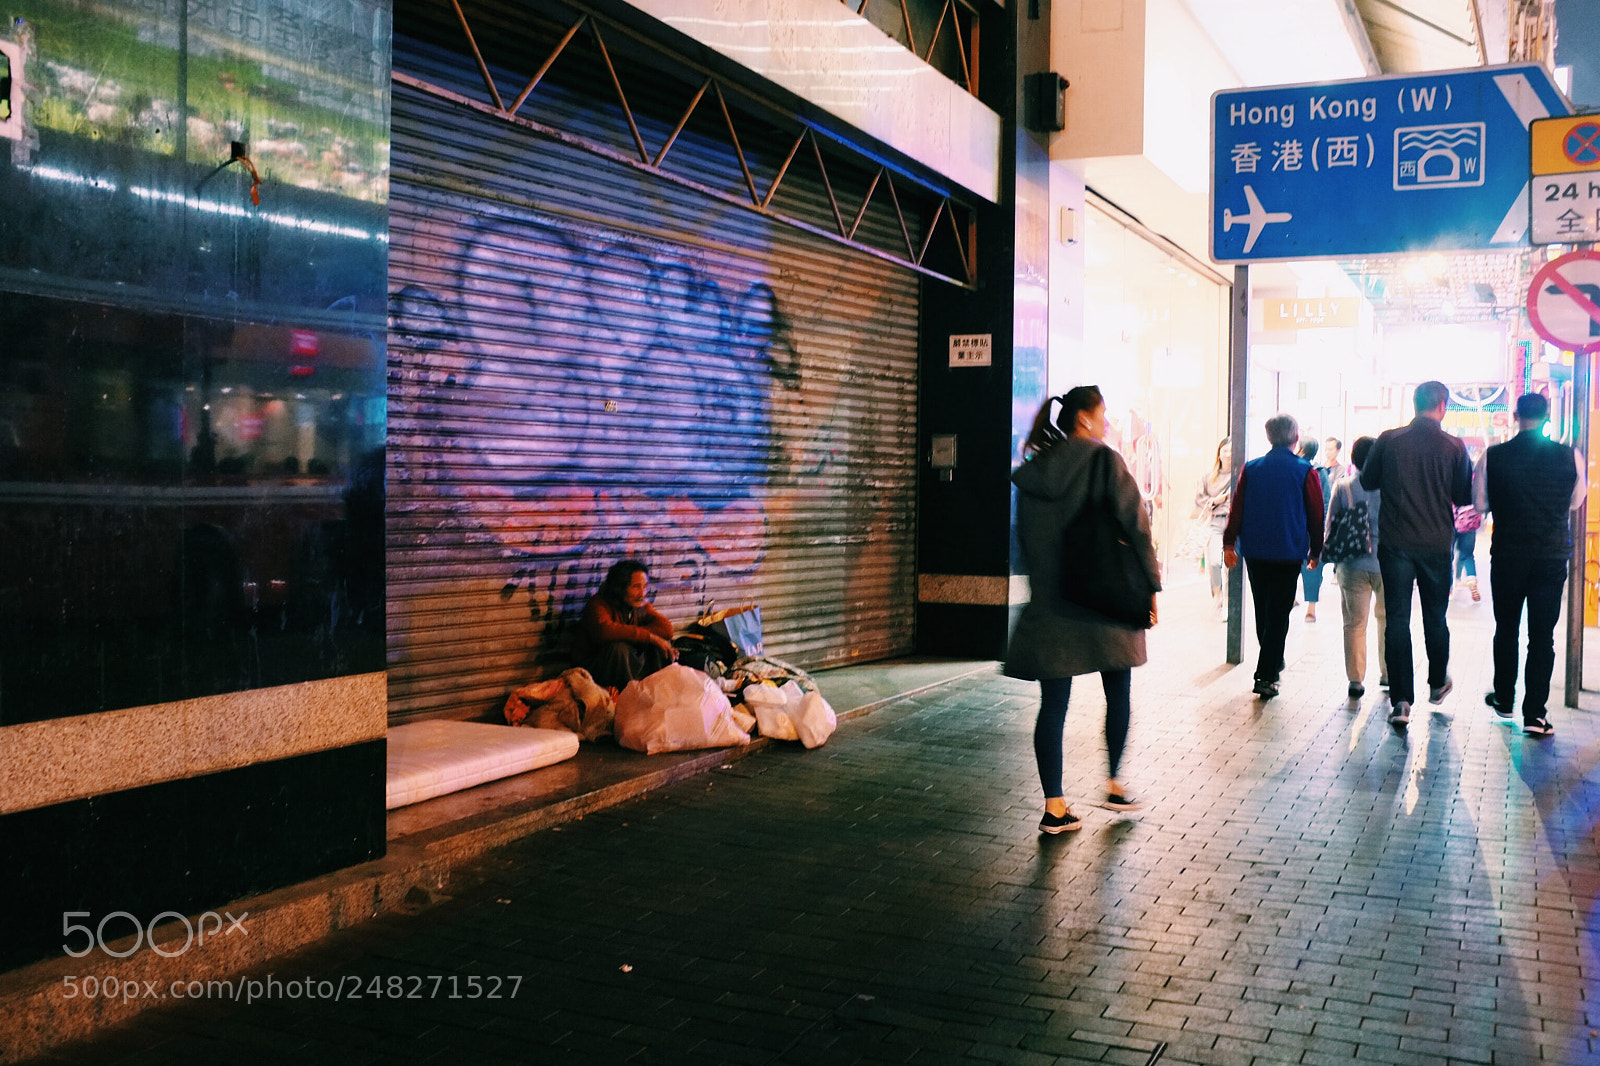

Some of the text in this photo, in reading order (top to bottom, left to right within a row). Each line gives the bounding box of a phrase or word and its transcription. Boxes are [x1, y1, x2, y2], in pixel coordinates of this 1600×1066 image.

[1230, 83, 1453, 128] Hong Kong (W)
[1399, 160, 1416, 177] 西
[1463, 156, 1478, 174] W
[1544, 183, 1580, 202] 24
[1280, 302, 1339, 318] LILLY
